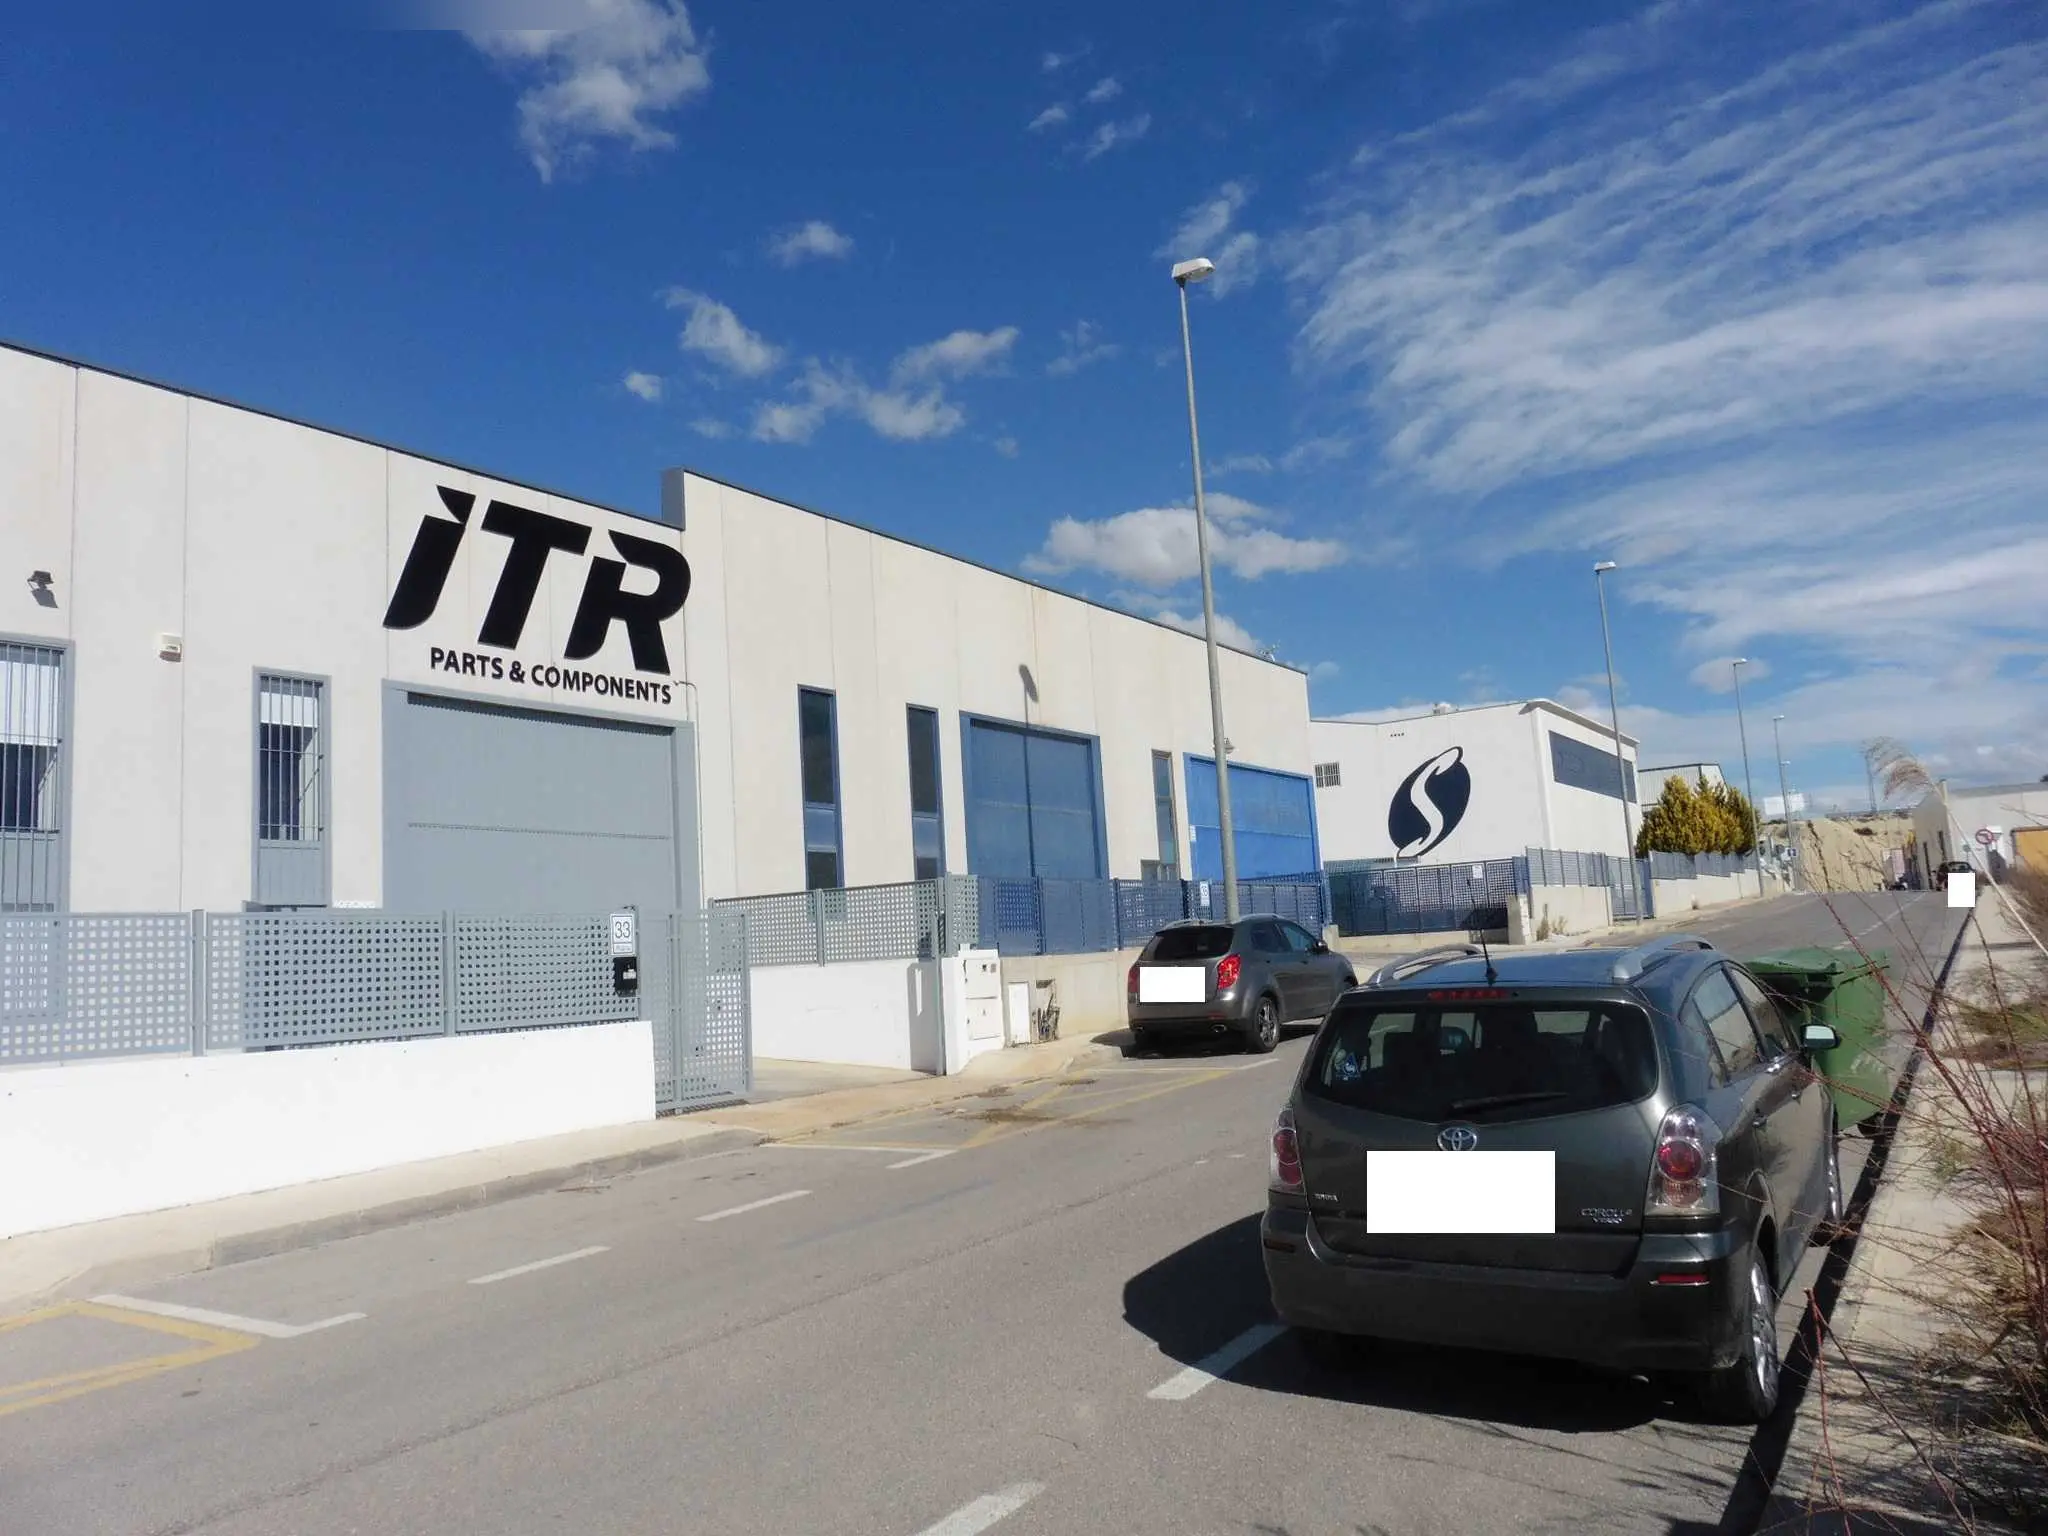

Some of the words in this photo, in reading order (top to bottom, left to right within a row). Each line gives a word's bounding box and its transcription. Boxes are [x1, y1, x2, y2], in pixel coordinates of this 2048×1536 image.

[430, 647, 504, 680] PARTS
[509, 660, 525, 683] &
[531, 664, 673, 704] COMPONENTS
[615, 921, 630, 938] 33
